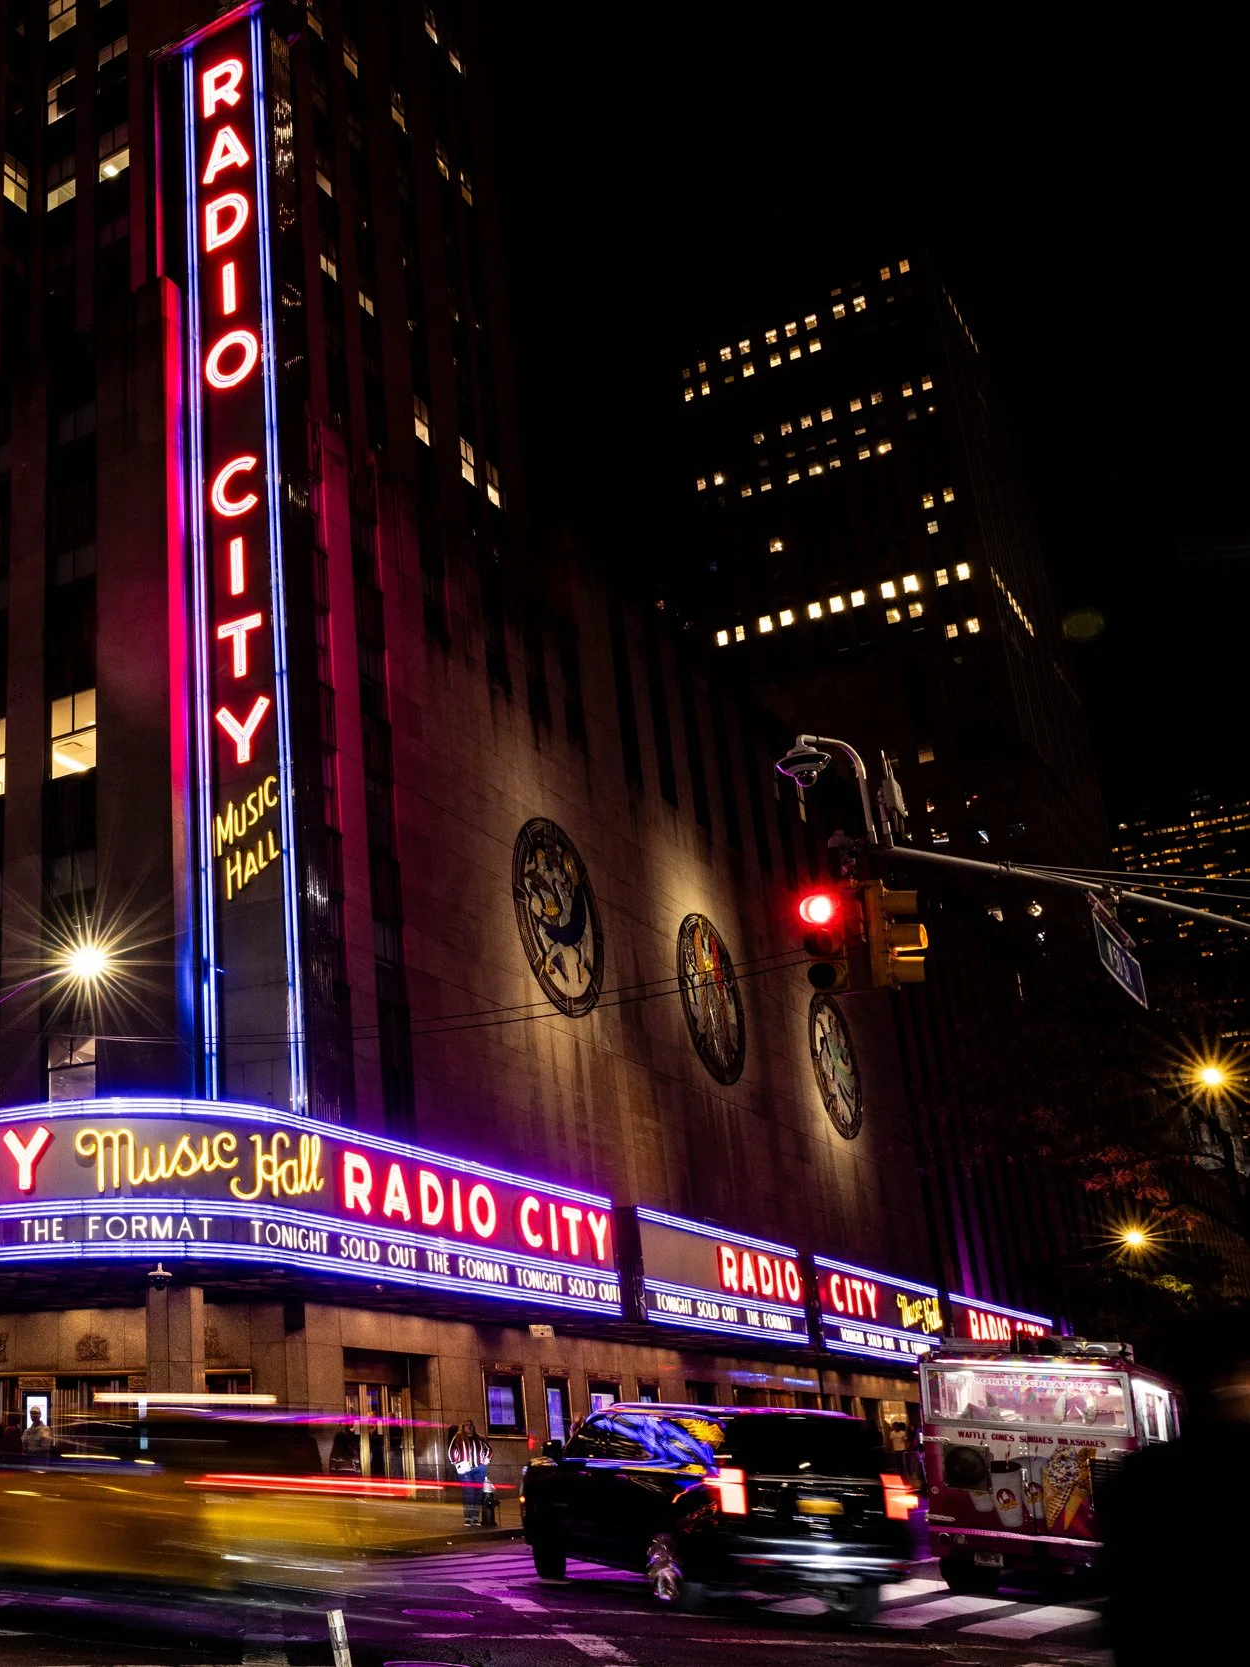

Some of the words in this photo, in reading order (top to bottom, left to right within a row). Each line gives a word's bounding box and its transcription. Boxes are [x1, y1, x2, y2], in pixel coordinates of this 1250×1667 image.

[201, 58, 258, 389] RADIO
[211, 456, 271, 765] CITY
[75, 1127, 239, 1193] Music
[229, 1131, 325, 1201] Hall
[342, 1150, 497, 1239] RADIO
[519, 1195, 608, 1261] CITY
[20, 1217, 65, 1243] THE
[88, 1215, 213, 1240] FORMAT
[250, 1219, 329, 1255] TONIGHT
[340, 1235, 380, 1263] SOLD
[387, 1244, 417, 1270] OUT
[425, 1250, 452, 1275] THE
[457, 1256, 509, 1285] FORMAT
[515, 1267, 563, 1294] TONIGHT
[567, 1276, 596, 1299] SOLD
[719, 1245, 801, 1302] RADIO
[829, 1273, 879, 1320] CITY
[967, 1309, 1012, 1341] RADIO
[655, 1292, 693, 1316] TONIGHT
[696, 1300, 720, 1320] SOLD
[721, 1305, 738, 1323] OUT
[745, 1309, 761, 1328] THE
[763, 1312, 792, 1332] FORMAT
[957, 1430, 987, 1440] WAFFLE
[991, 1434, 1015, 1442] CONES
[1019, 1435, 1054, 1445] SUNDAES
[1057, 1437, 1107, 1448] MILKSHAKES
